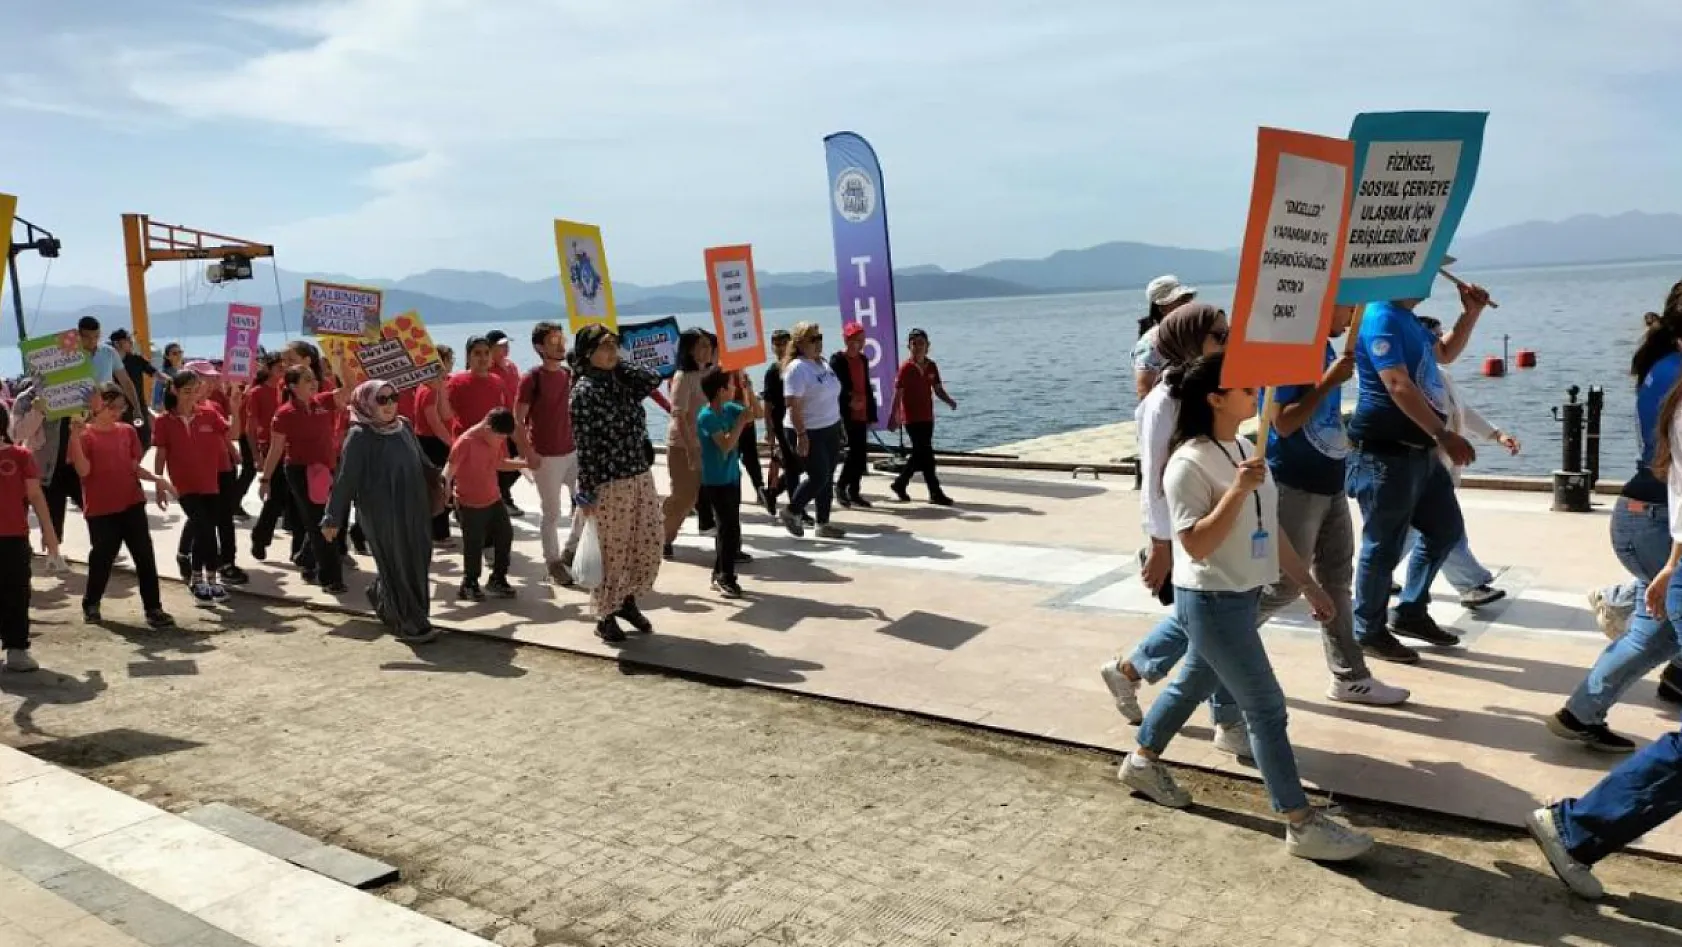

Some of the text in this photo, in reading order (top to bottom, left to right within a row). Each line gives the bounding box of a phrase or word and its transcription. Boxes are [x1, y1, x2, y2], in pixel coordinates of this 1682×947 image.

[1385, 149, 1435, 174] FİZİKSEL,
[1359, 180, 1451, 200] SOSYAL ÇERVEYE
[1361, 201, 1436, 225] ULAŞMAK İÇİN
[1349, 224, 1431, 248] ERİŞİLEBİLİRLİK
[1350, 250, 1417, 268] HAKKIMIZDIR
